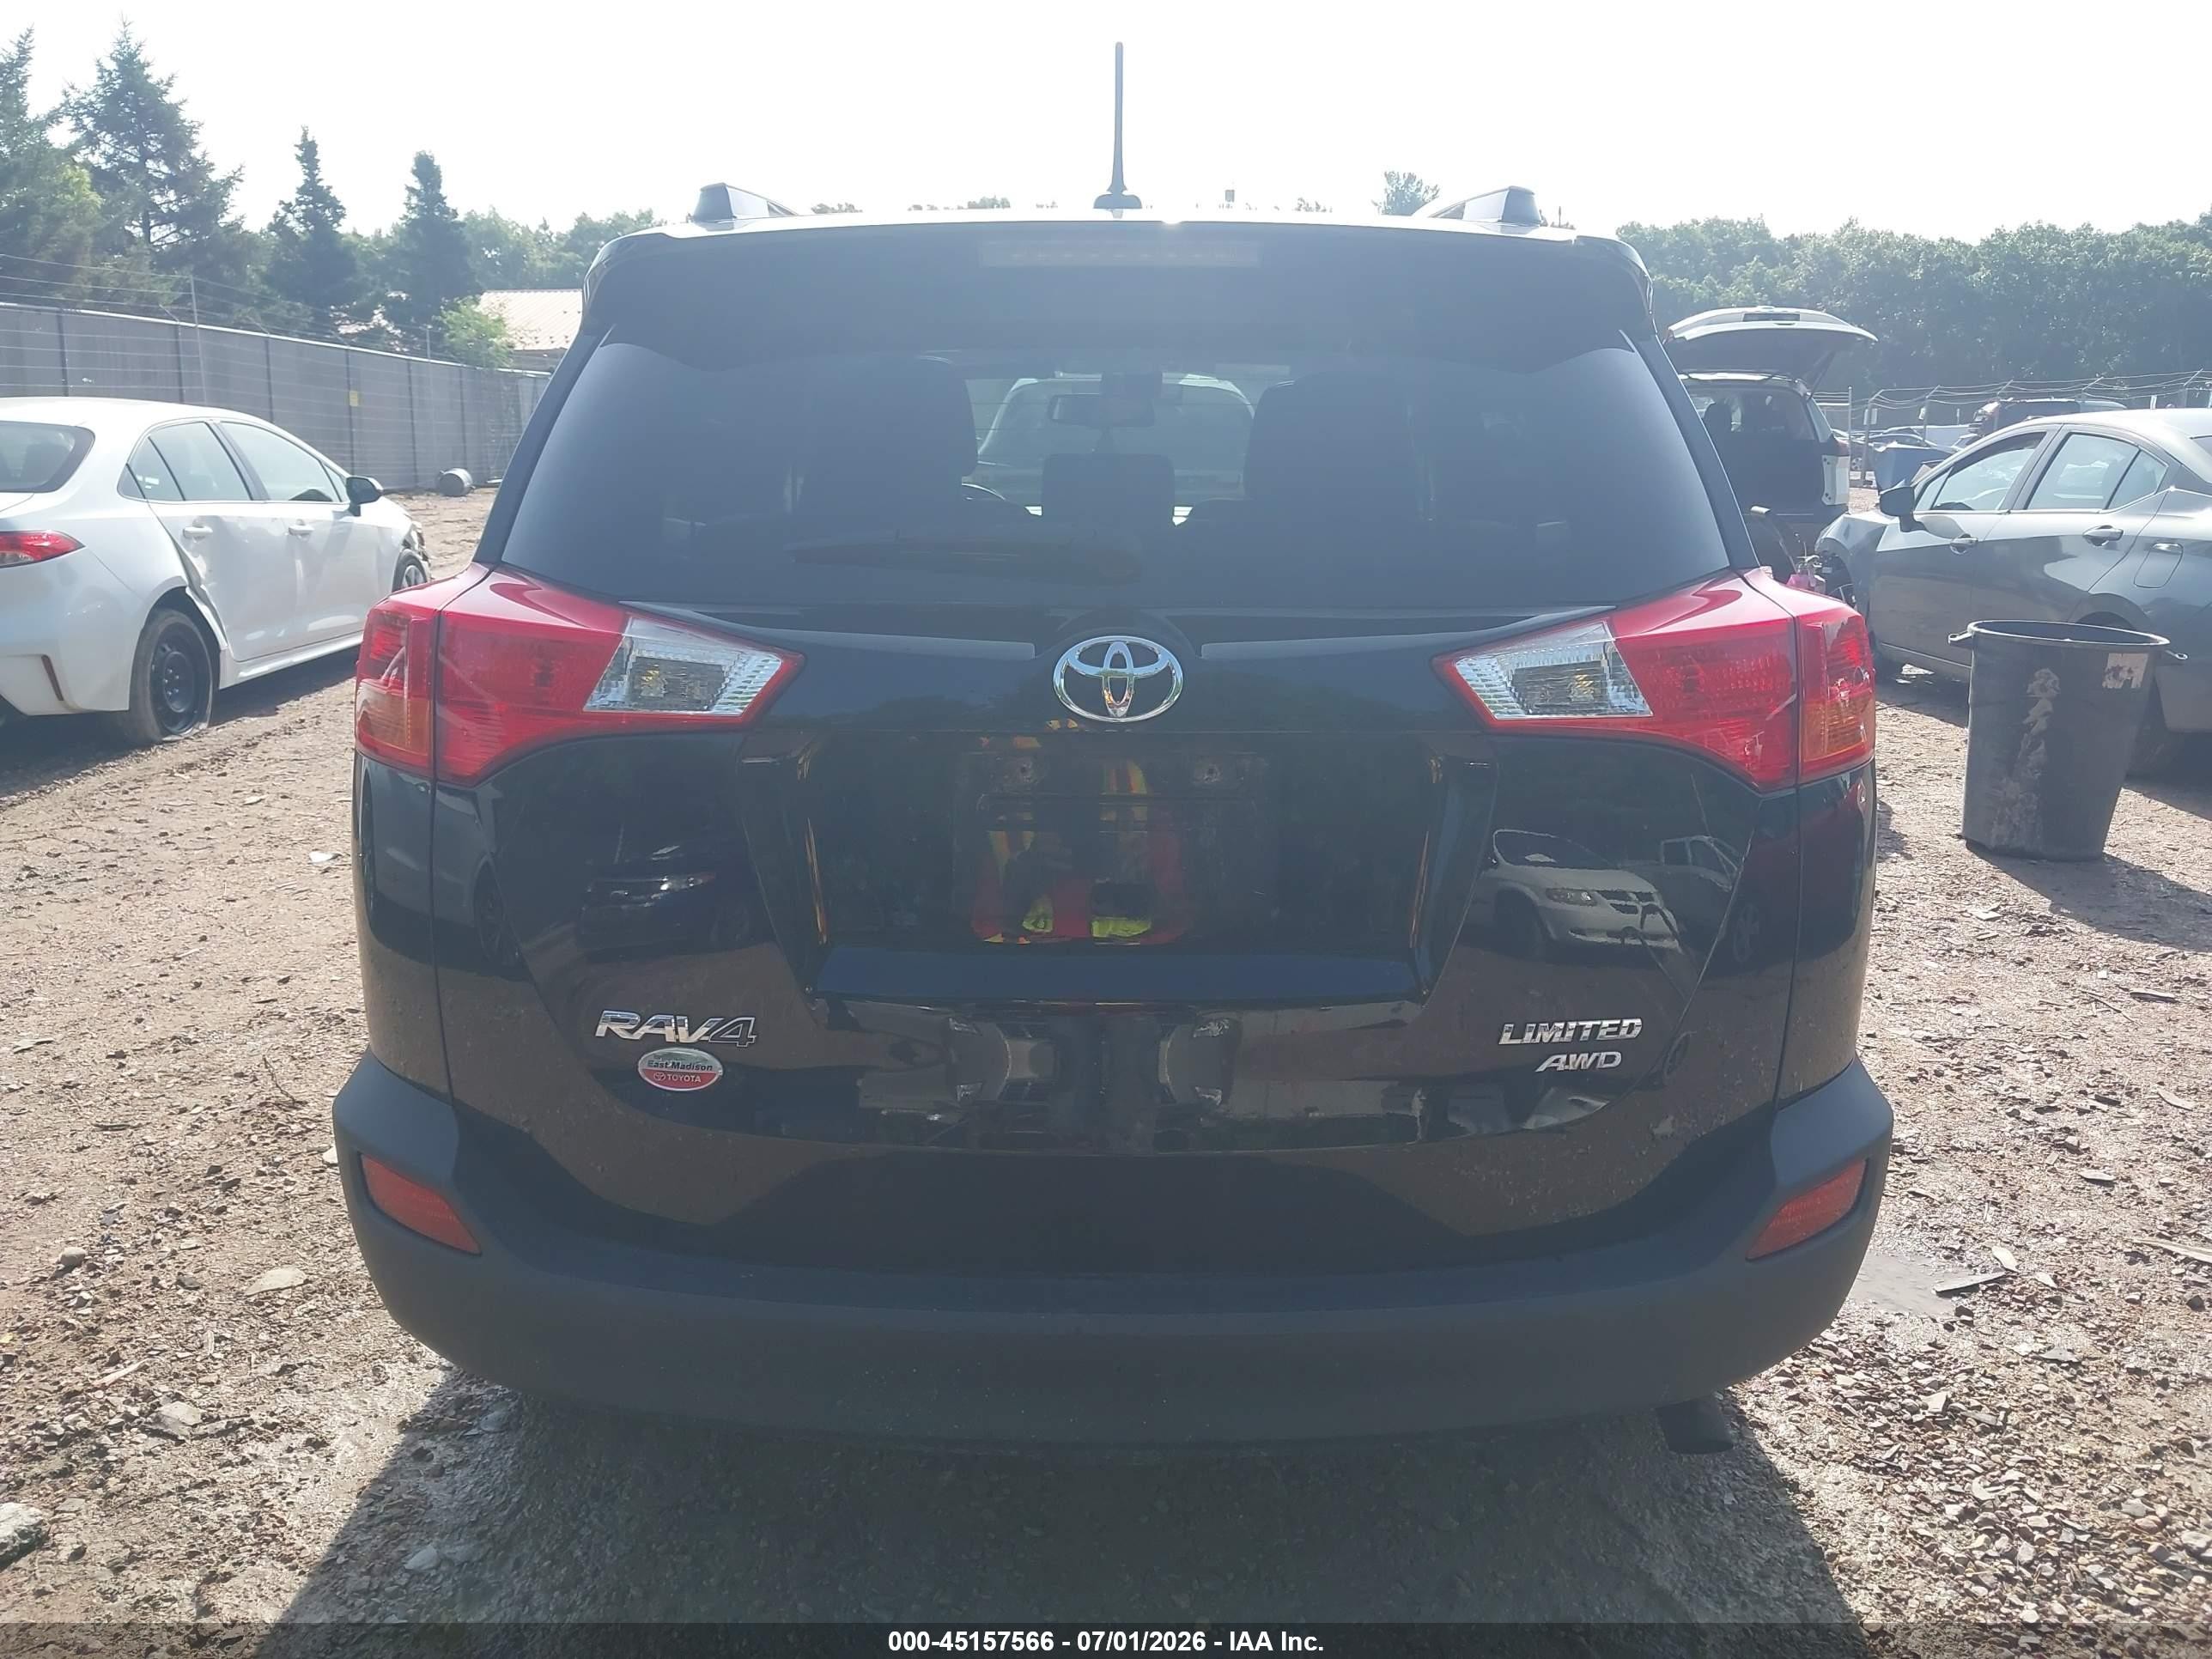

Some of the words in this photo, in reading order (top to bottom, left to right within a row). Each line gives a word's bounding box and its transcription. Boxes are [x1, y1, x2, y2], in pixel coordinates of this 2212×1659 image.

[595, 1010, 757, 1048] RAV4
[1498, 1018, 1643, 1045] LIMITED
[647, 1060, 670, 1069] East
[671, 1061, 713, 1072] Madison
[1534, 1051, 1622, 1073] AWD
[667, 1073, 702, 1083] TOYOTA
